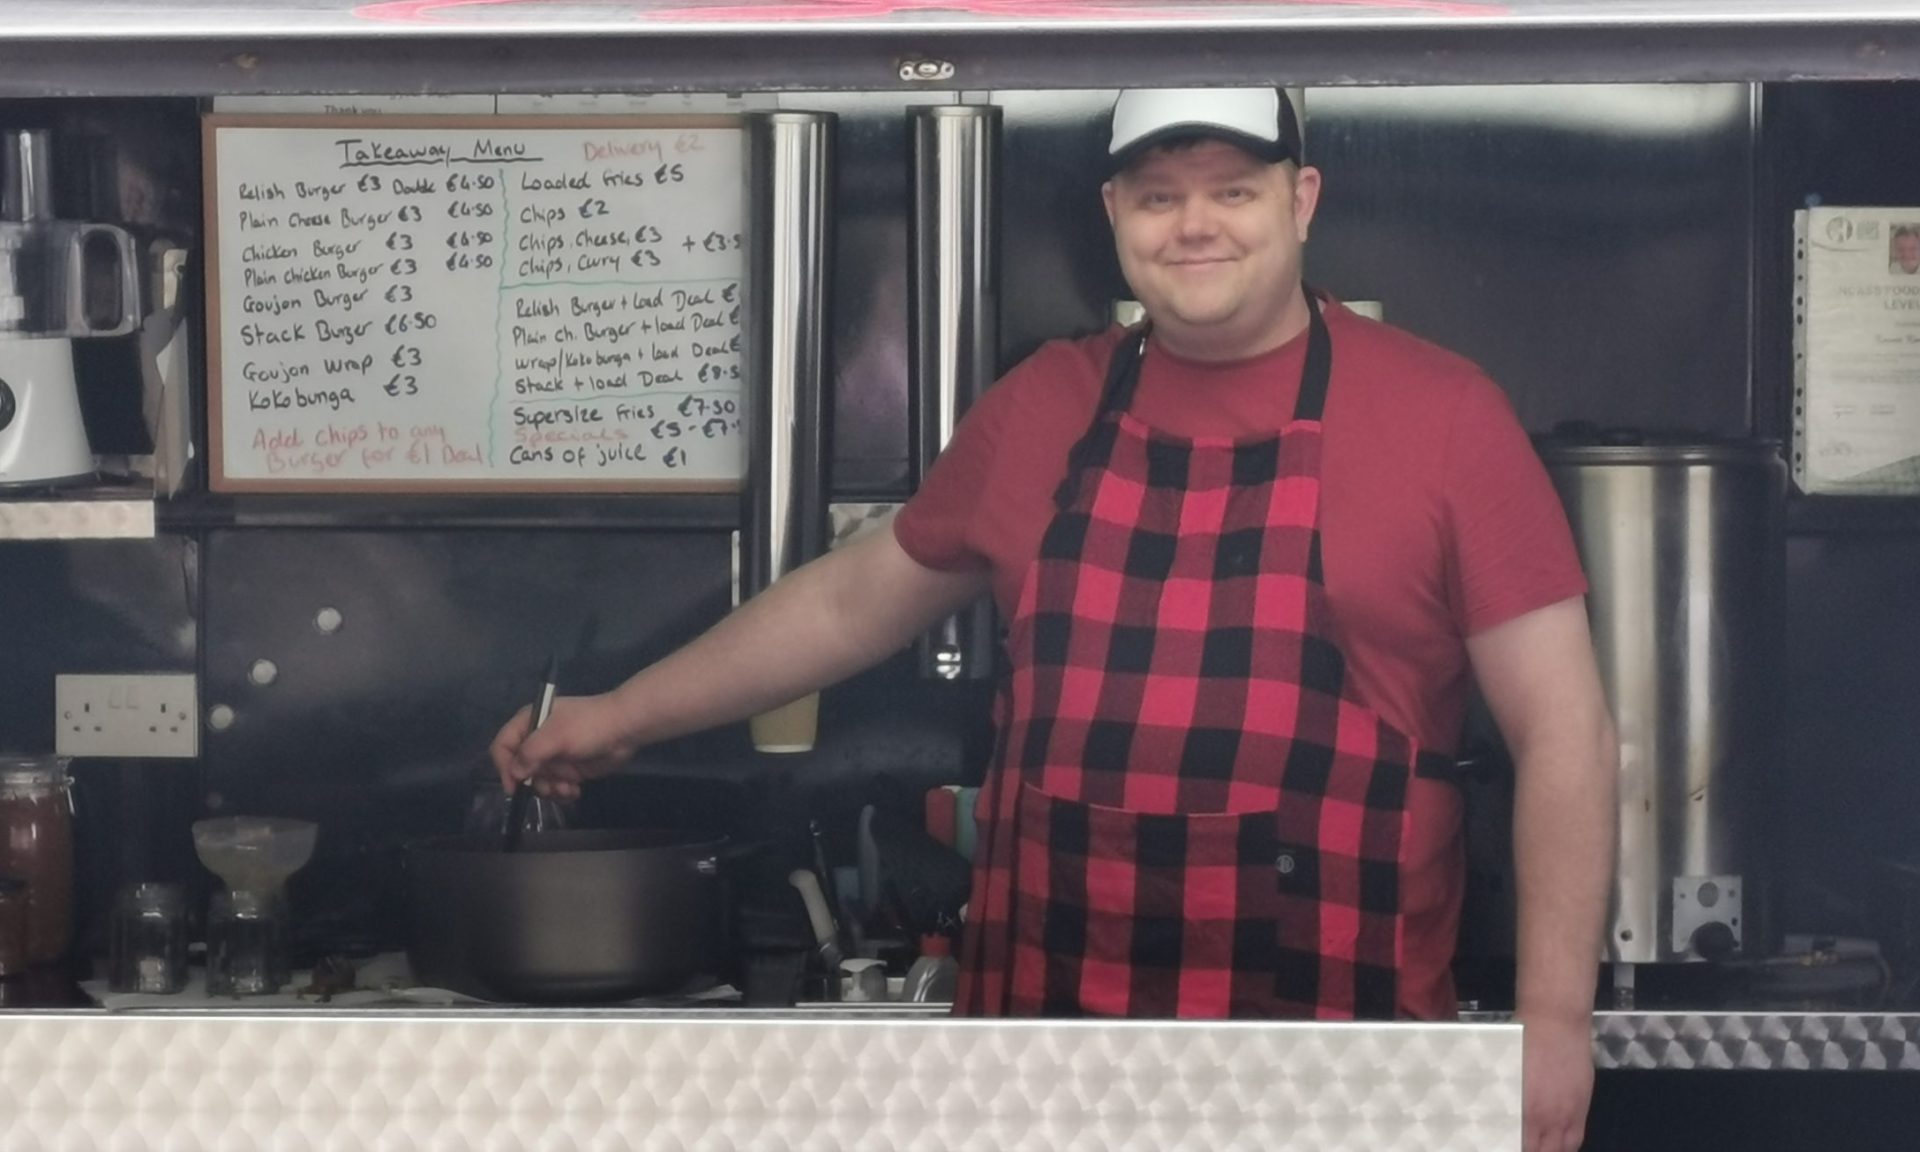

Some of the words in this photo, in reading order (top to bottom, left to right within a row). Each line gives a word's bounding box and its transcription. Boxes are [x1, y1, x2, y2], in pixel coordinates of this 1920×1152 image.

[335, 139, 451, 167] Takeaway
[472, 139, 526, 158] Menu
[583, 140, 664, 162] Delivery
[239, 182, 286, 201] Relish
[295, 180, 346, 202] Burger
[358, 173, 382, 192] €3
[521, 171, 592, 191] Loaded
[654, 163, 685, 184] €5
[239, 210, 280, 231] Plain
[287, 211, 332, 229] Cheese
[340, 207, 393, 231] Burger
[397, 205, 423, 223] €3
[520, 204, 566, 228] Chips
[578, 198, 610, 219] €2
[241, 245, 298, 264] Chicken
[313, 239, 362, 260] Burger
[385, 231, 414, 250] €3
[635, 225, 663, 243] €3
[244, 267, 278, 288] Plain
[337, 262, 384, 284] Burger
[390, 257, 417, 276] €3
[576, 253, 621, 273] Curry
[629, 249, 662, 268] €3
[242, 294, 302, 316] Goujon
[314, 288, 369, 312] Burger
[384, 284, 413, 304] €3
[515, 297, 560, 319] Relish
[569, 295, 617, 318] Burger
[670, 289, 715, 313] Deal
[240, 323, 307, 346] Stack
[315, 318, 373, 345] Burger
[512, 325, 547, 348] Plain
[583, 320, 637, 344] Burger
[690, 312, 725, 333] Deal
[691, 340, 729, 359] Deal
[242, 361, 310, 384] Goujon
[391, 345, 423, 368] €3
[383, 374, 418, 398] €3
[514, 375, 565, 395] Stack
[636, 369, 684, 388] Deal
[512, 406, 603, 431] Supersize
[253, 428, 304, 451] Add
[377, 422, 400, 442] to
[410, 425, 446, 444] any
[267, 448, 348, 474] Burger
[361, 446, 394, 470] for
[440, 443, 484, 466] Deal
[509, 445, 554, 466] Cans
[597, 443, 647, 468] juice
[663, 446, 686, 469] €1
